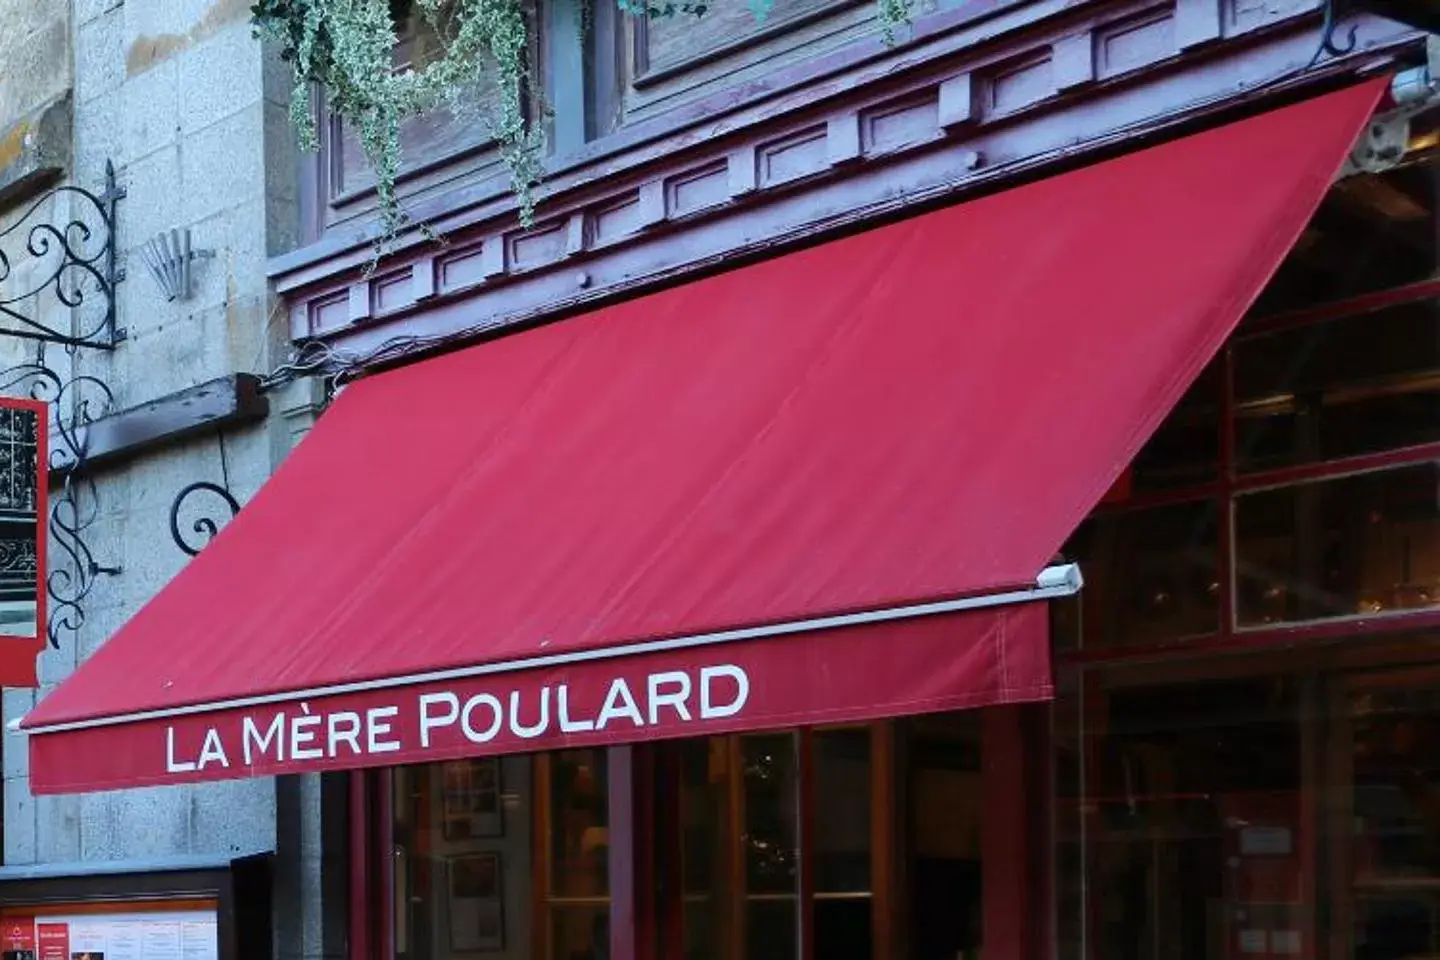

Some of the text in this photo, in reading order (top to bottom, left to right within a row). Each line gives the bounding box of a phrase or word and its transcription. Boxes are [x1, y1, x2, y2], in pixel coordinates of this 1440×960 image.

[164, 664, 751, 773] LA MÈRE POULARD
